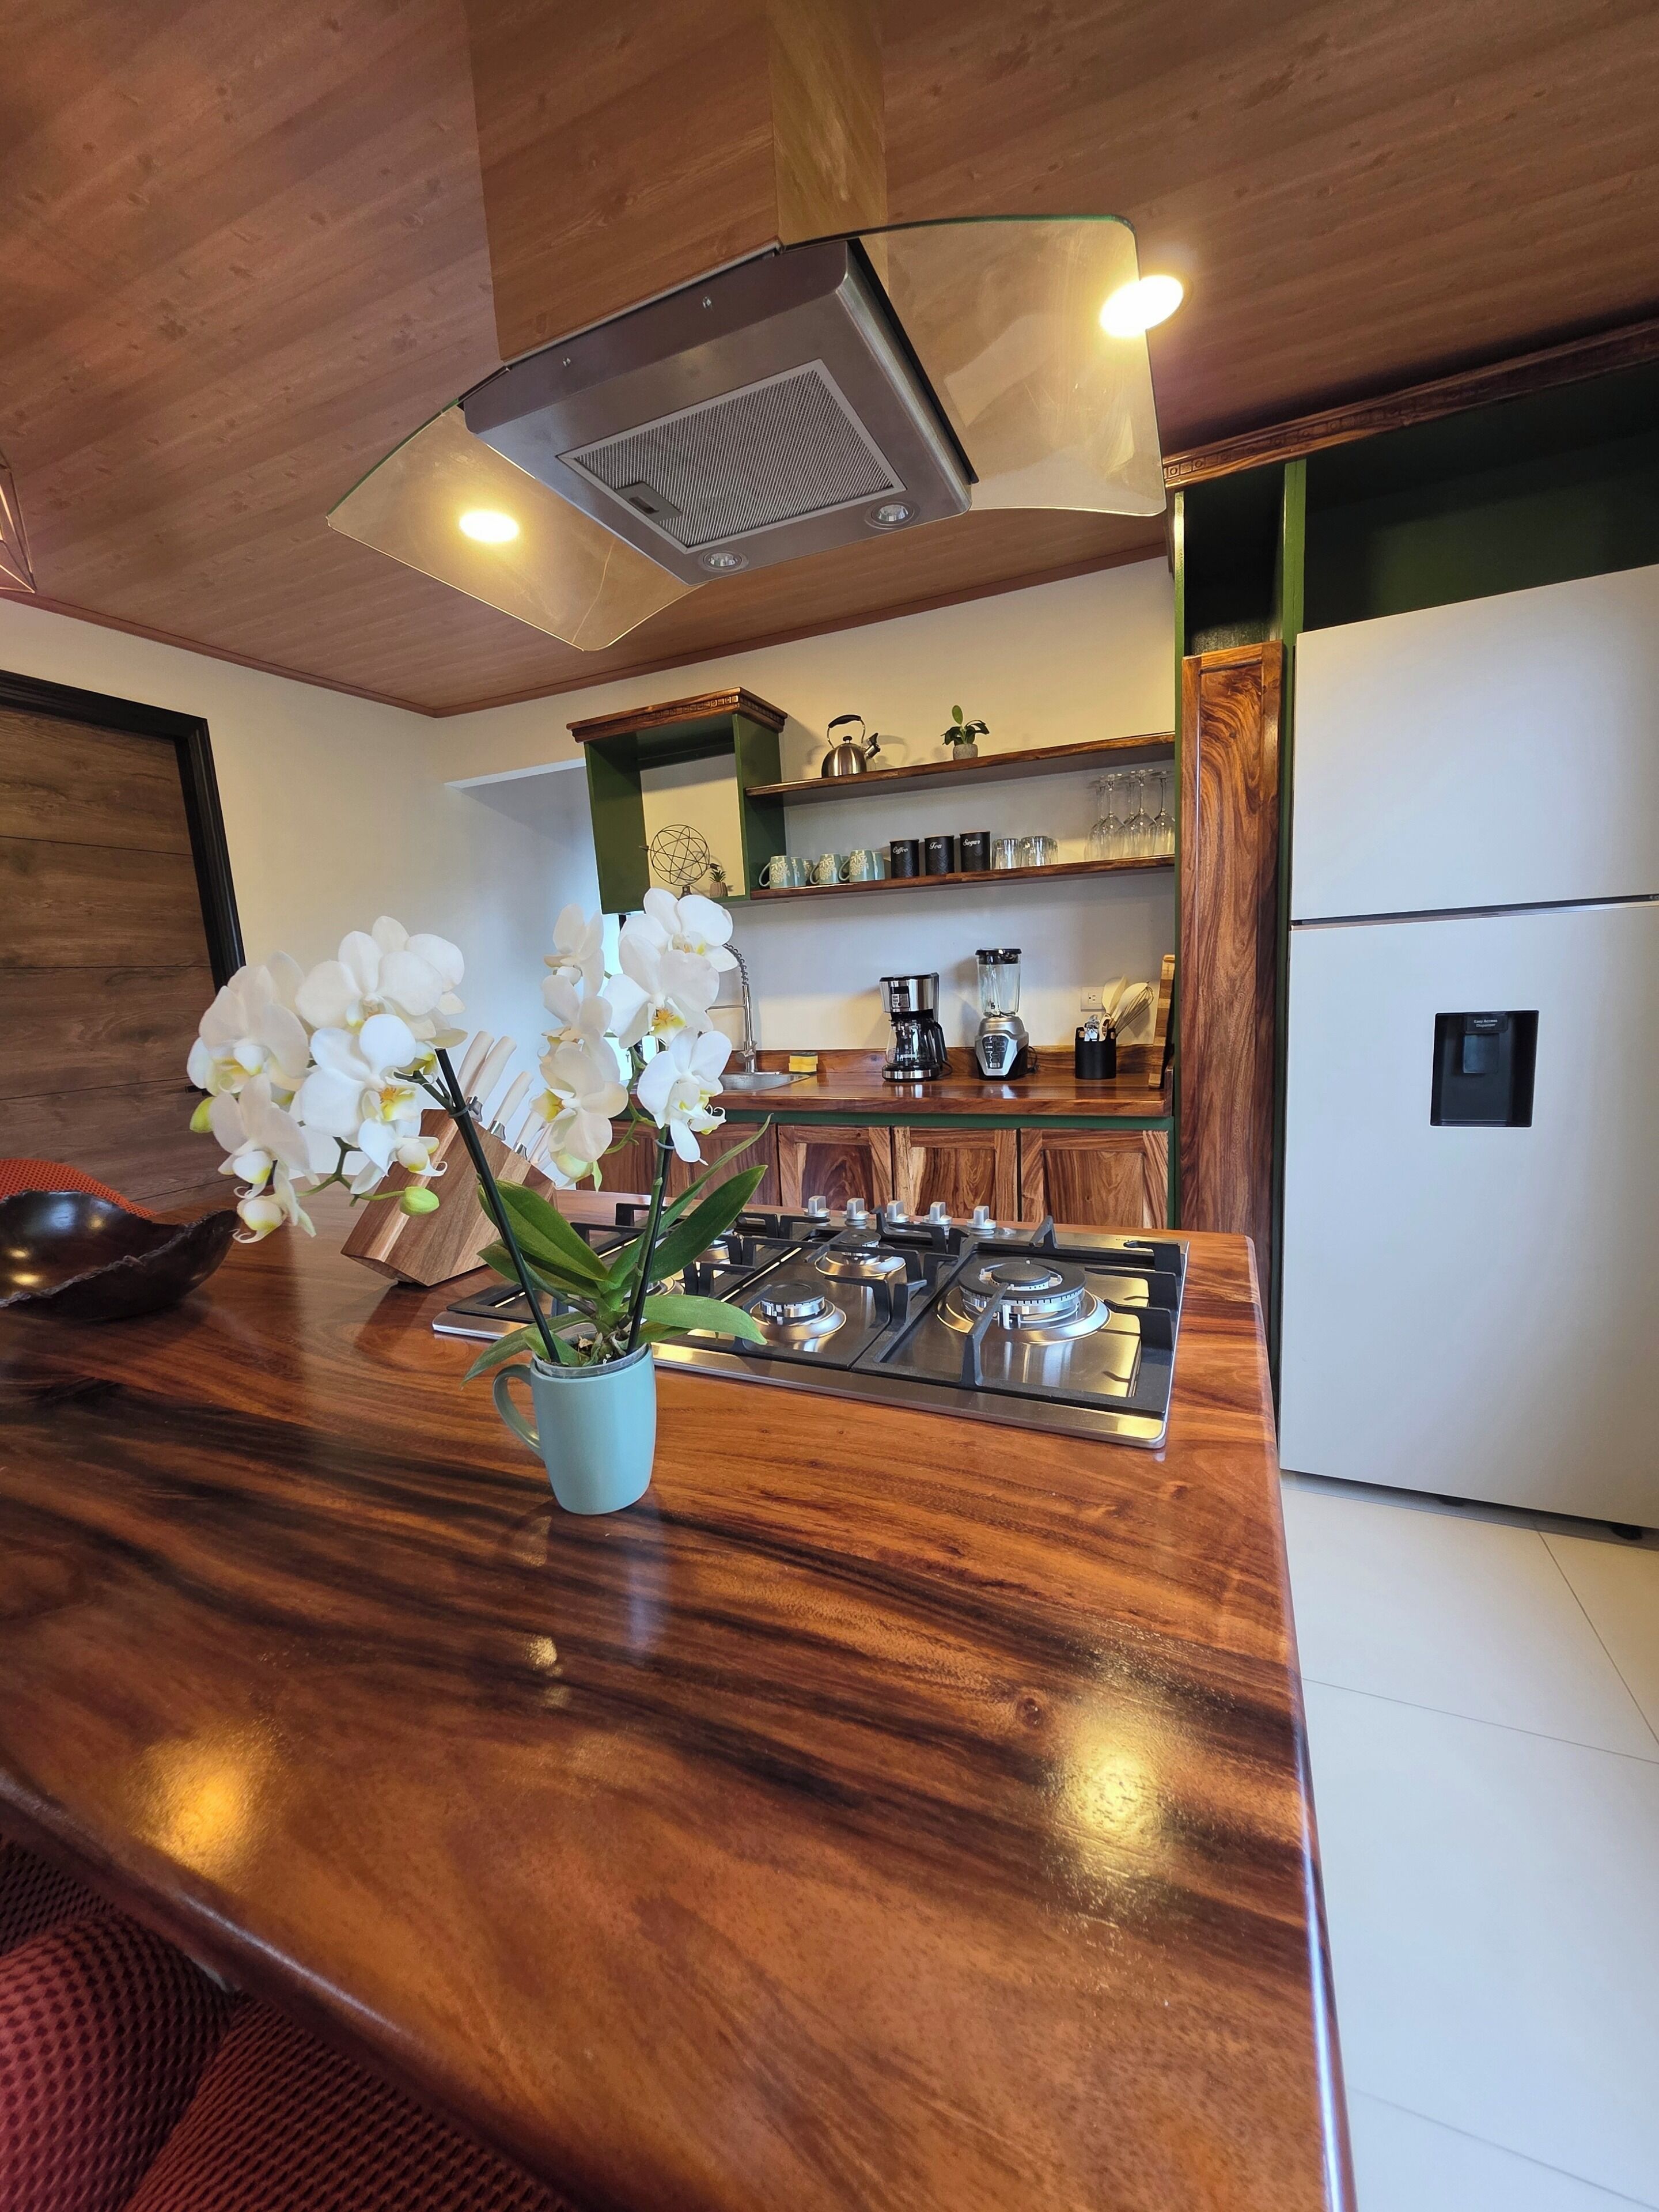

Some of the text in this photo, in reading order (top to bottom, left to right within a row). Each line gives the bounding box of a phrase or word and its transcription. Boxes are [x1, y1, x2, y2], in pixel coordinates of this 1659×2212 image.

[929, 842, 942, 850] Tea
[963, 839, 980, 847] Sugar
[893, 846, 908, 854] Coffee
